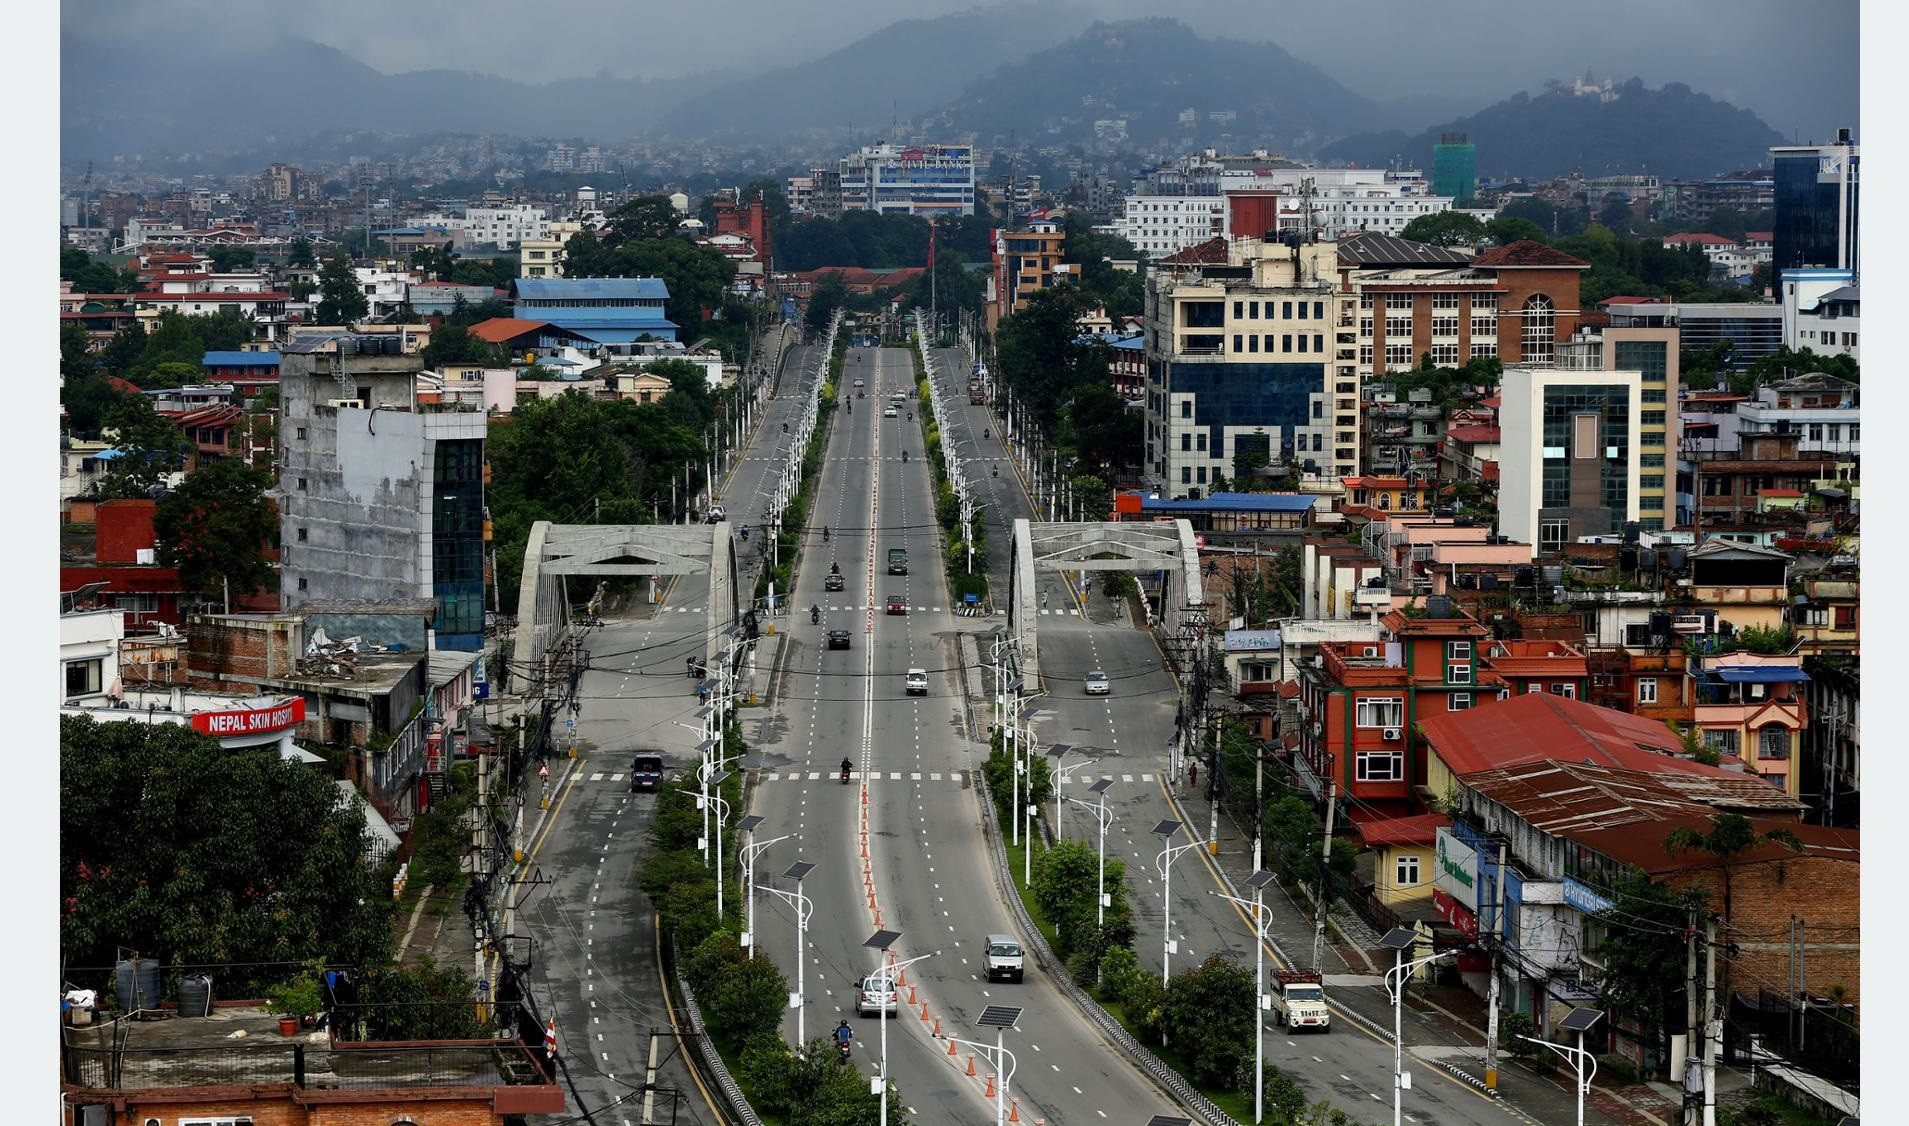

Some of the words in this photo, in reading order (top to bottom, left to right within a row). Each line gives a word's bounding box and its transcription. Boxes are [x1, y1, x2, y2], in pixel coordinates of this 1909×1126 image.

[900, 160, 929, 169] CIVIL
[936, 160, 963, 169] BANK
[209, 715, 246, 732] NEPAL
[249, 713, 270, 730] SKIN
